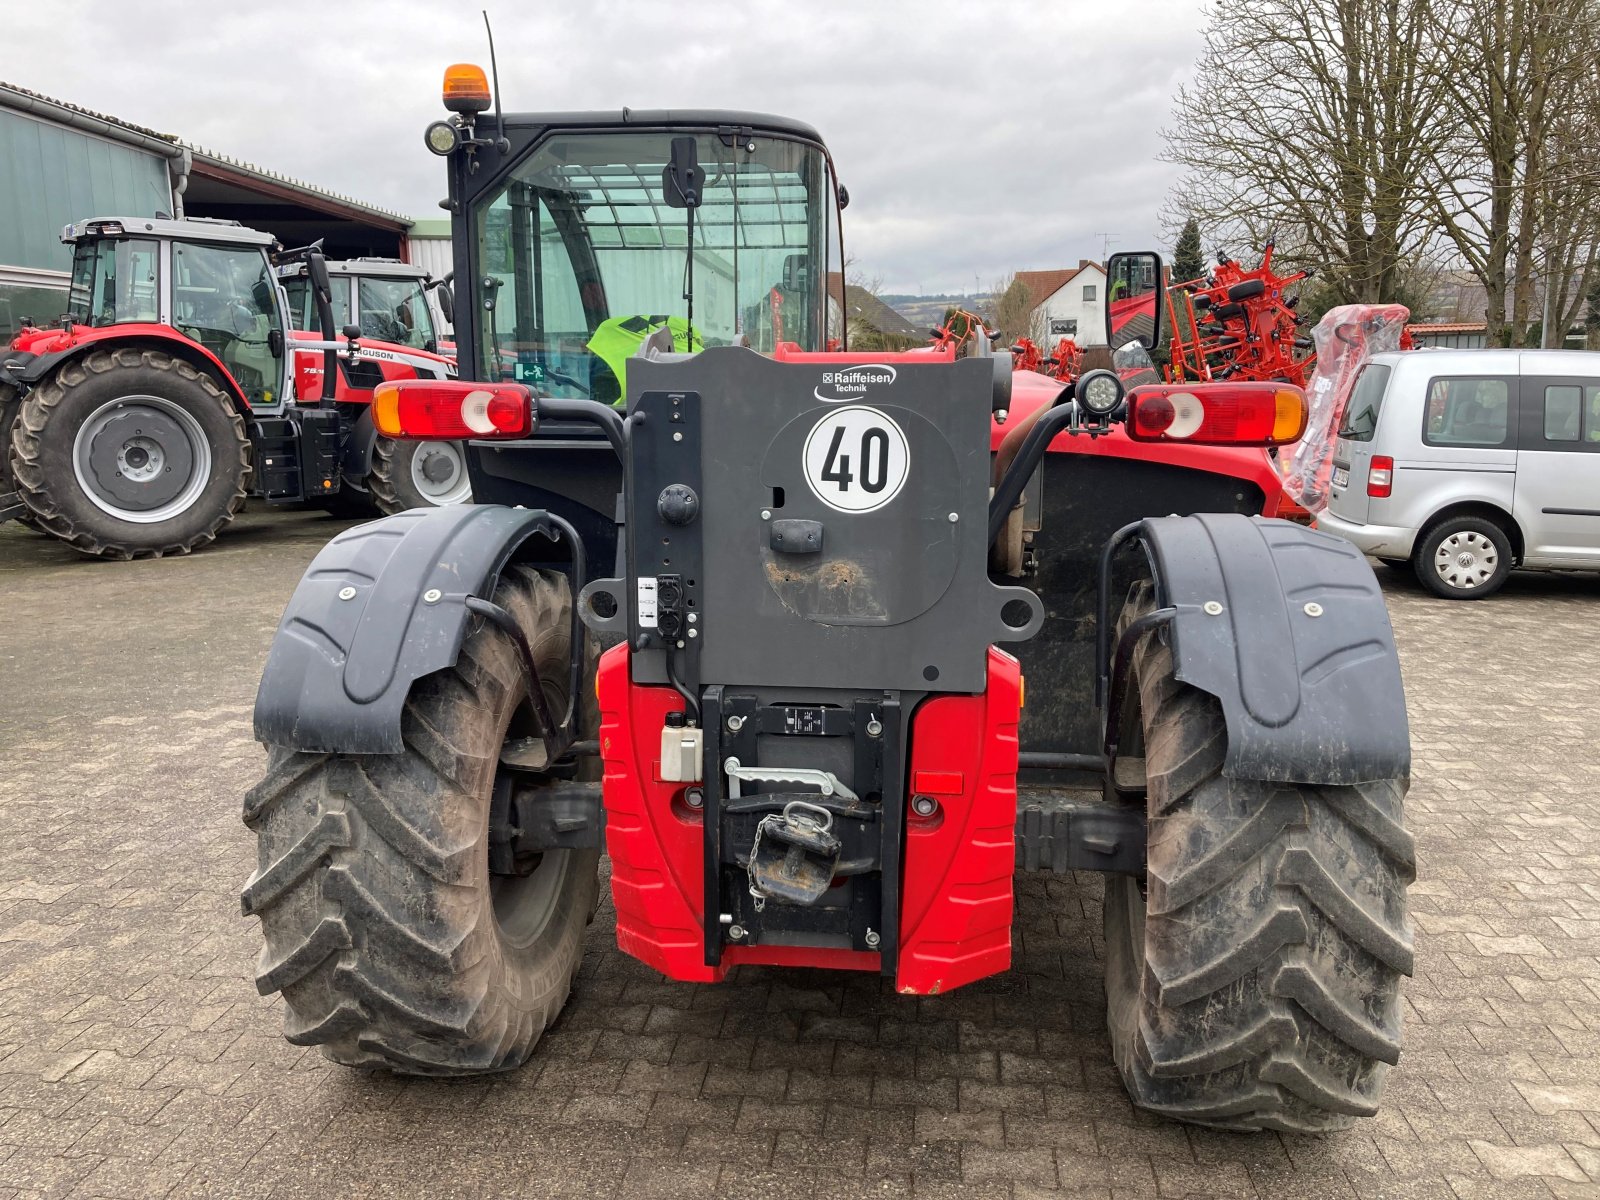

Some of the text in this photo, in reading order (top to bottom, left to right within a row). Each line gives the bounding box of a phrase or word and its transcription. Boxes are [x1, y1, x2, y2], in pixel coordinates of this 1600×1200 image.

[834, 372, 891, 383] Raiffeisen
[834, 384, 867, 392] Technik
[821, 426, 889, 494] 40
